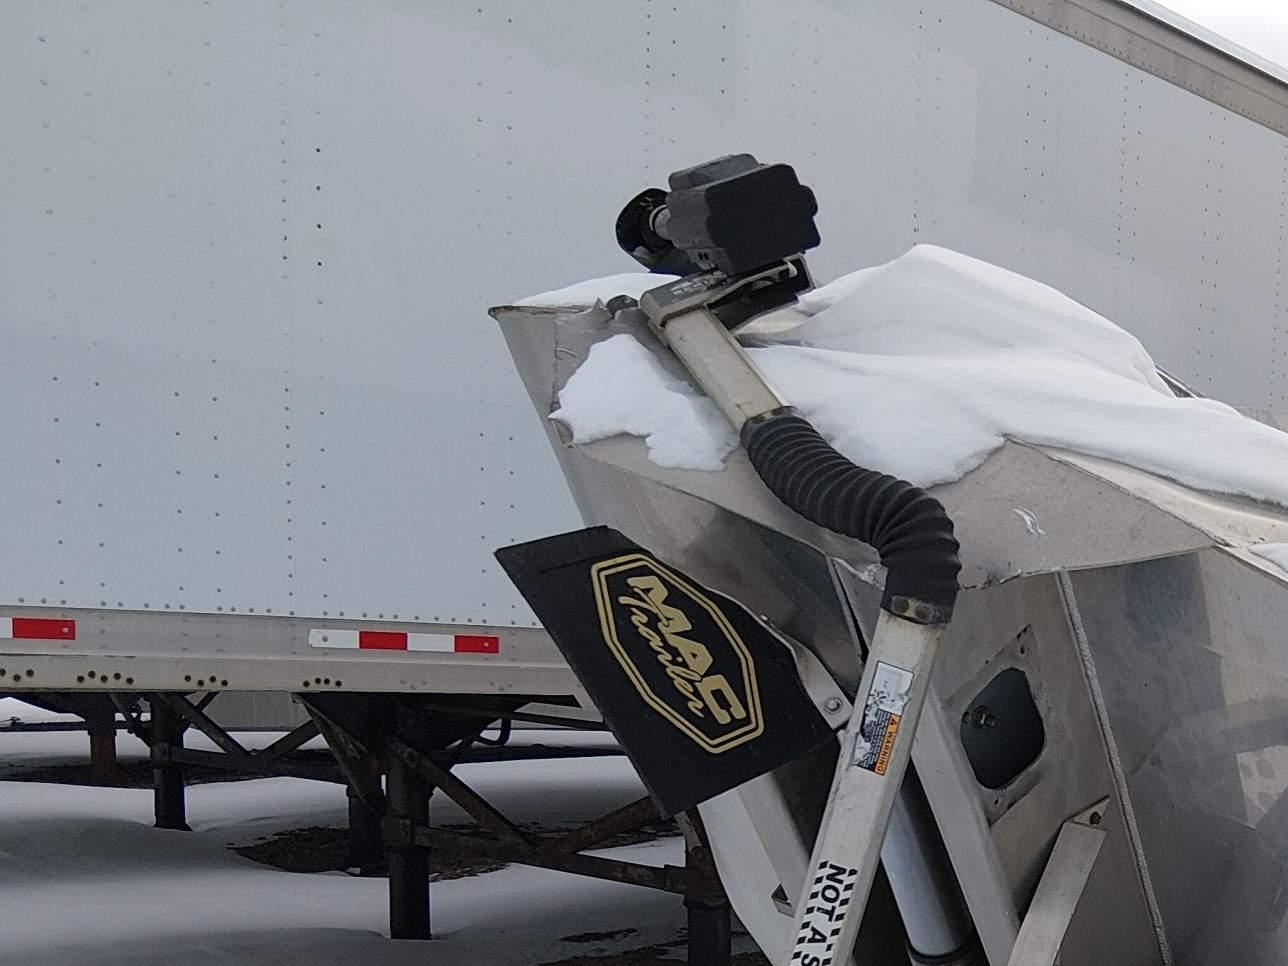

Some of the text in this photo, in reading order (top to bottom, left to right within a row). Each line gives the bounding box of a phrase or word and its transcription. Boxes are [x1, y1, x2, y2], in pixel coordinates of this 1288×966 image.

[618, 587, 705, 718] Trailer
[626, 575, 747, 725] MAC
[877, 731, 895, 773] WARNING
[816, 863, 848, 922] NOT
[807, 926, 828, 944] A
